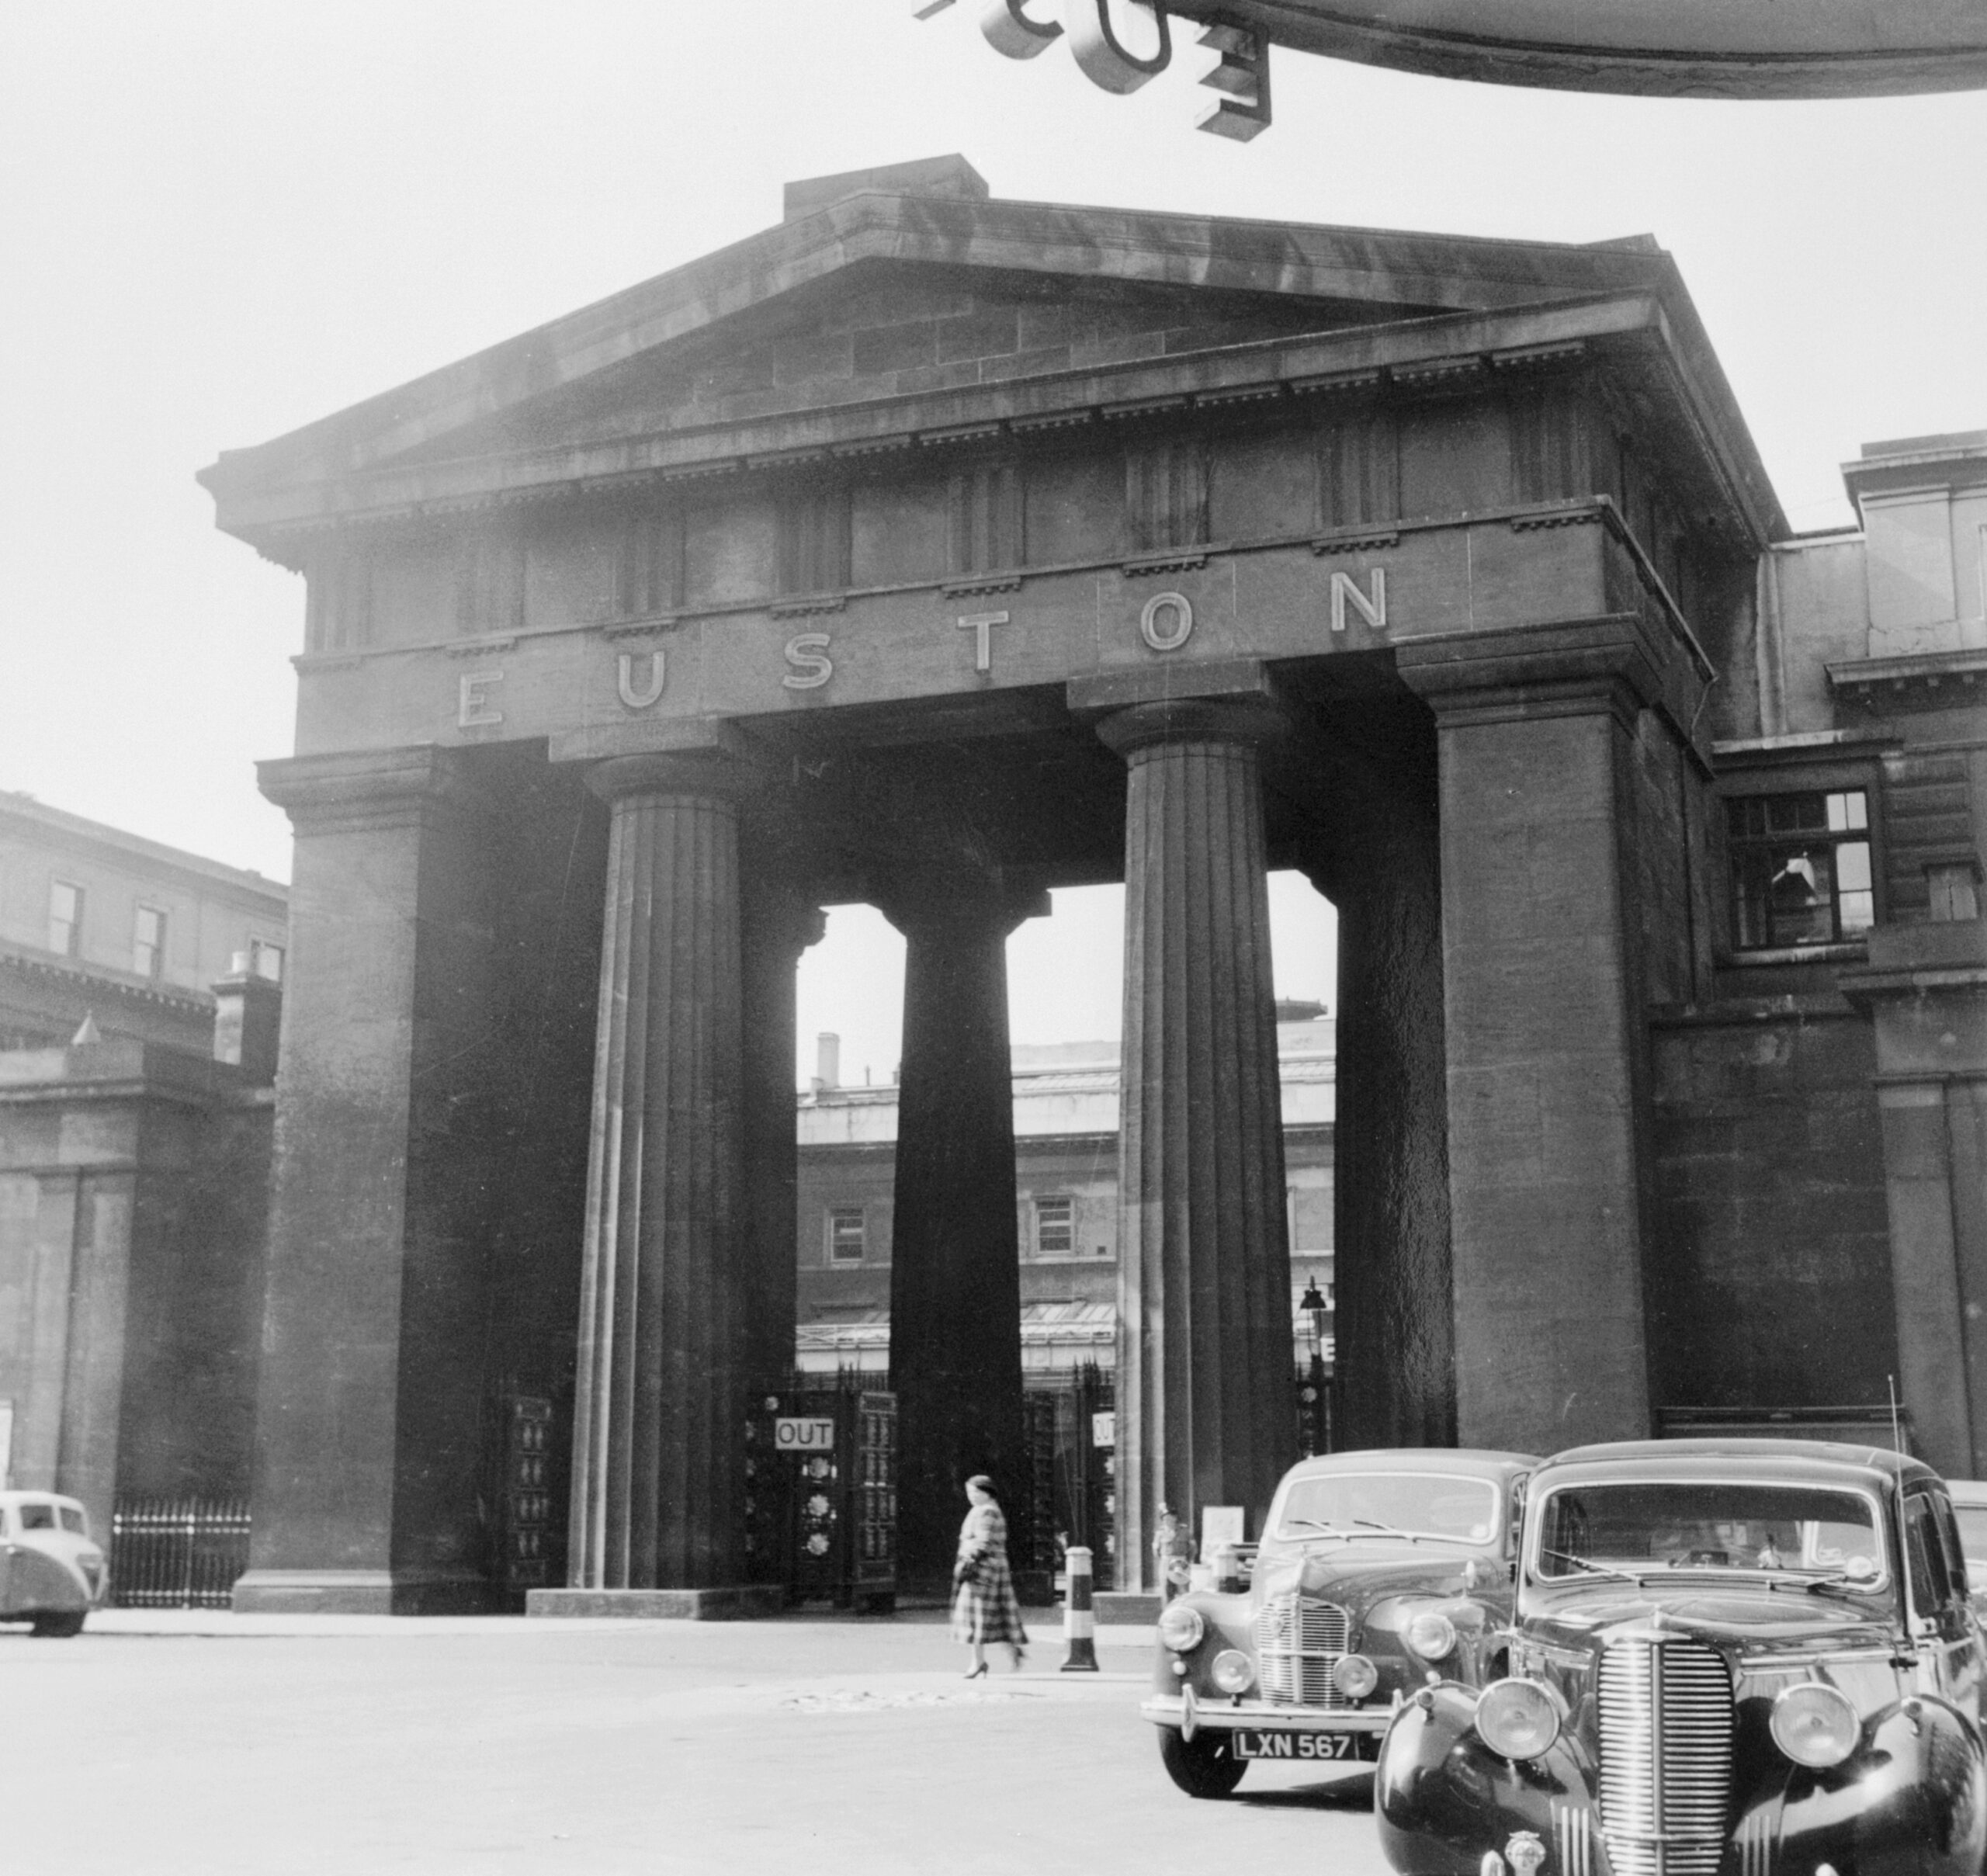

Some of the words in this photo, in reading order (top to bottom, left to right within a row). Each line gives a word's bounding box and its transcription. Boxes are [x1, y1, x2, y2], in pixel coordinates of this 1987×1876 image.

[458, 567, 1387, 727] EUSTON
[778, 1423, 831, 1444] OUT
[1239, 1733, 1292, 1757] LXN
[1298, 1735, 1351, 1759] 567
